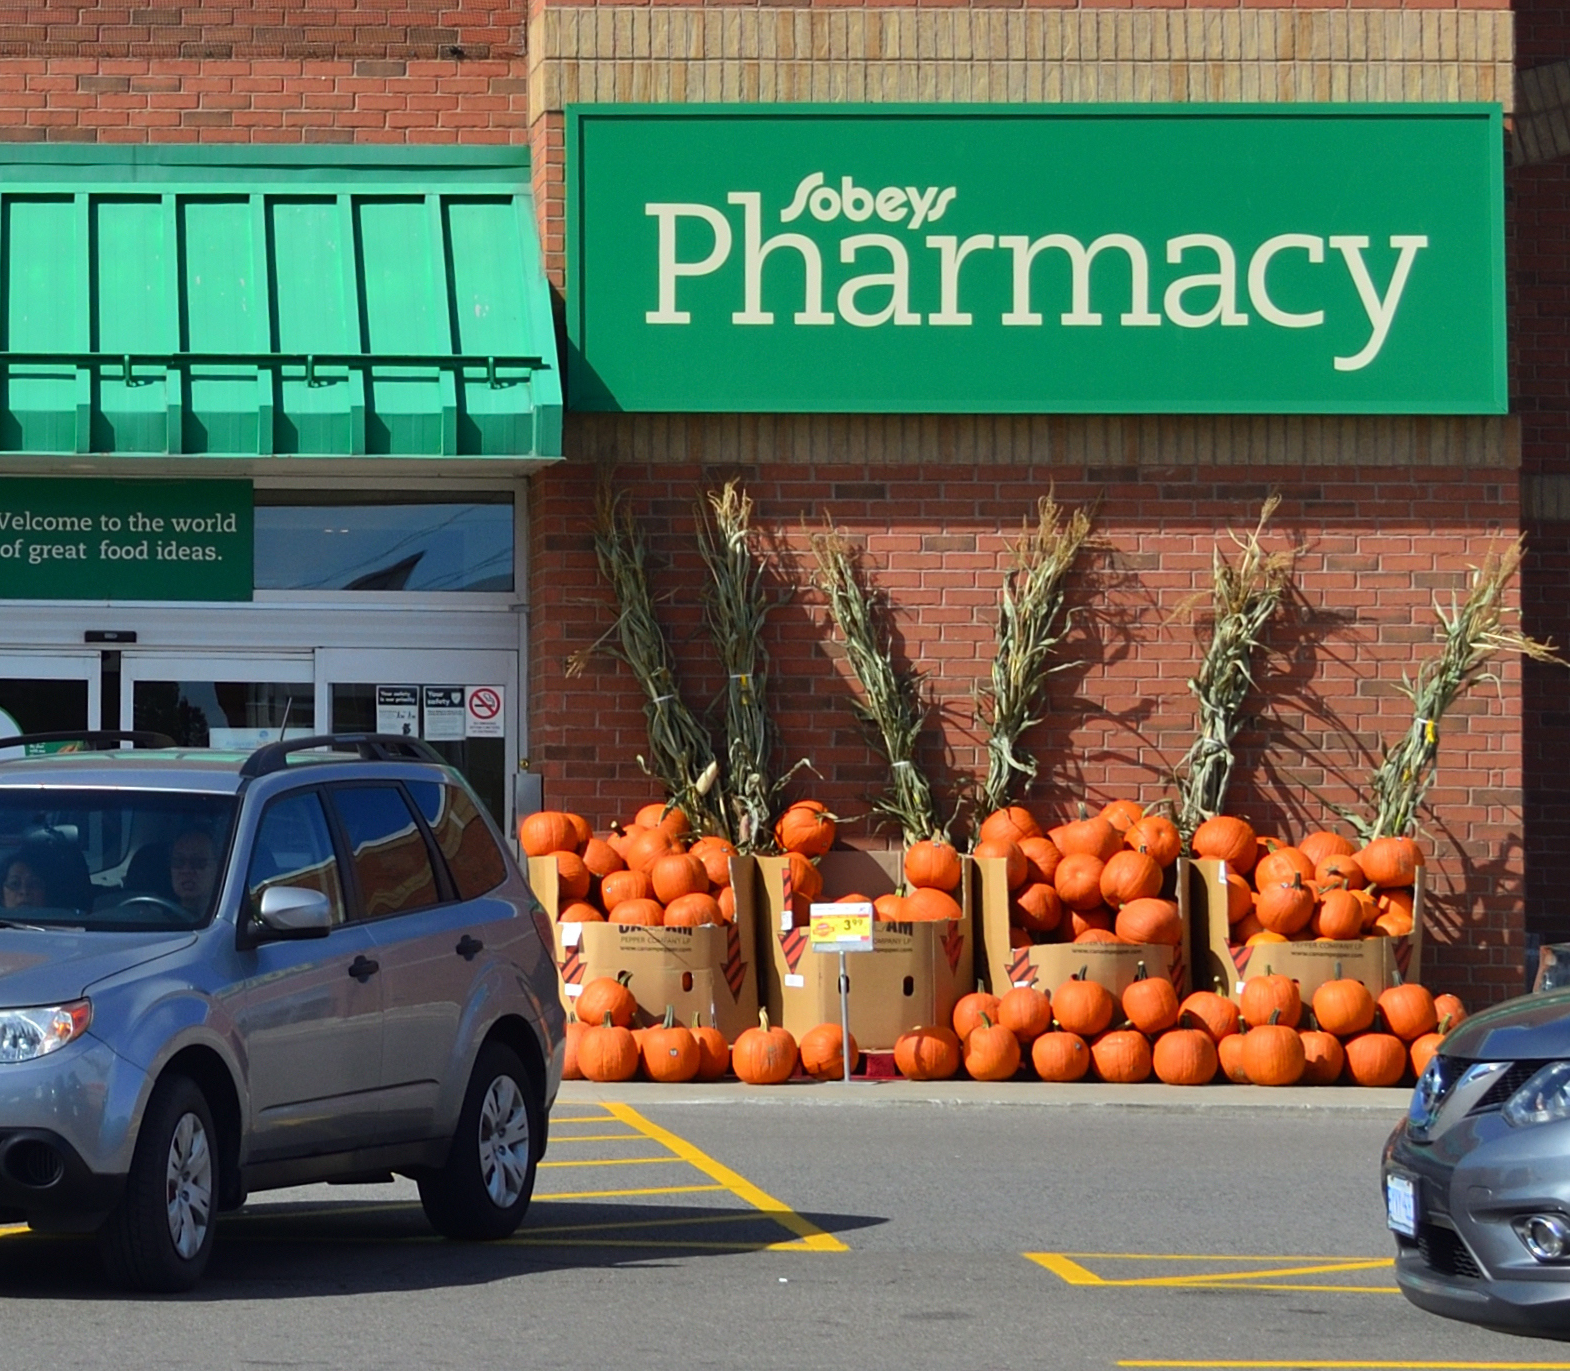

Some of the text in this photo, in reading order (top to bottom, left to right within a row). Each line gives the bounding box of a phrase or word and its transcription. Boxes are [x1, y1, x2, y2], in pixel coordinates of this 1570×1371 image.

[779, 170, 957, 229] Sobeys
[644, 190, 1429, 372] Pharmacy
[99, 513, 121, 532] to
[128, 512, 164, 532] the
[171, 513, 237, 533] world
[0, 539, 223, 564] of great food ideas.
